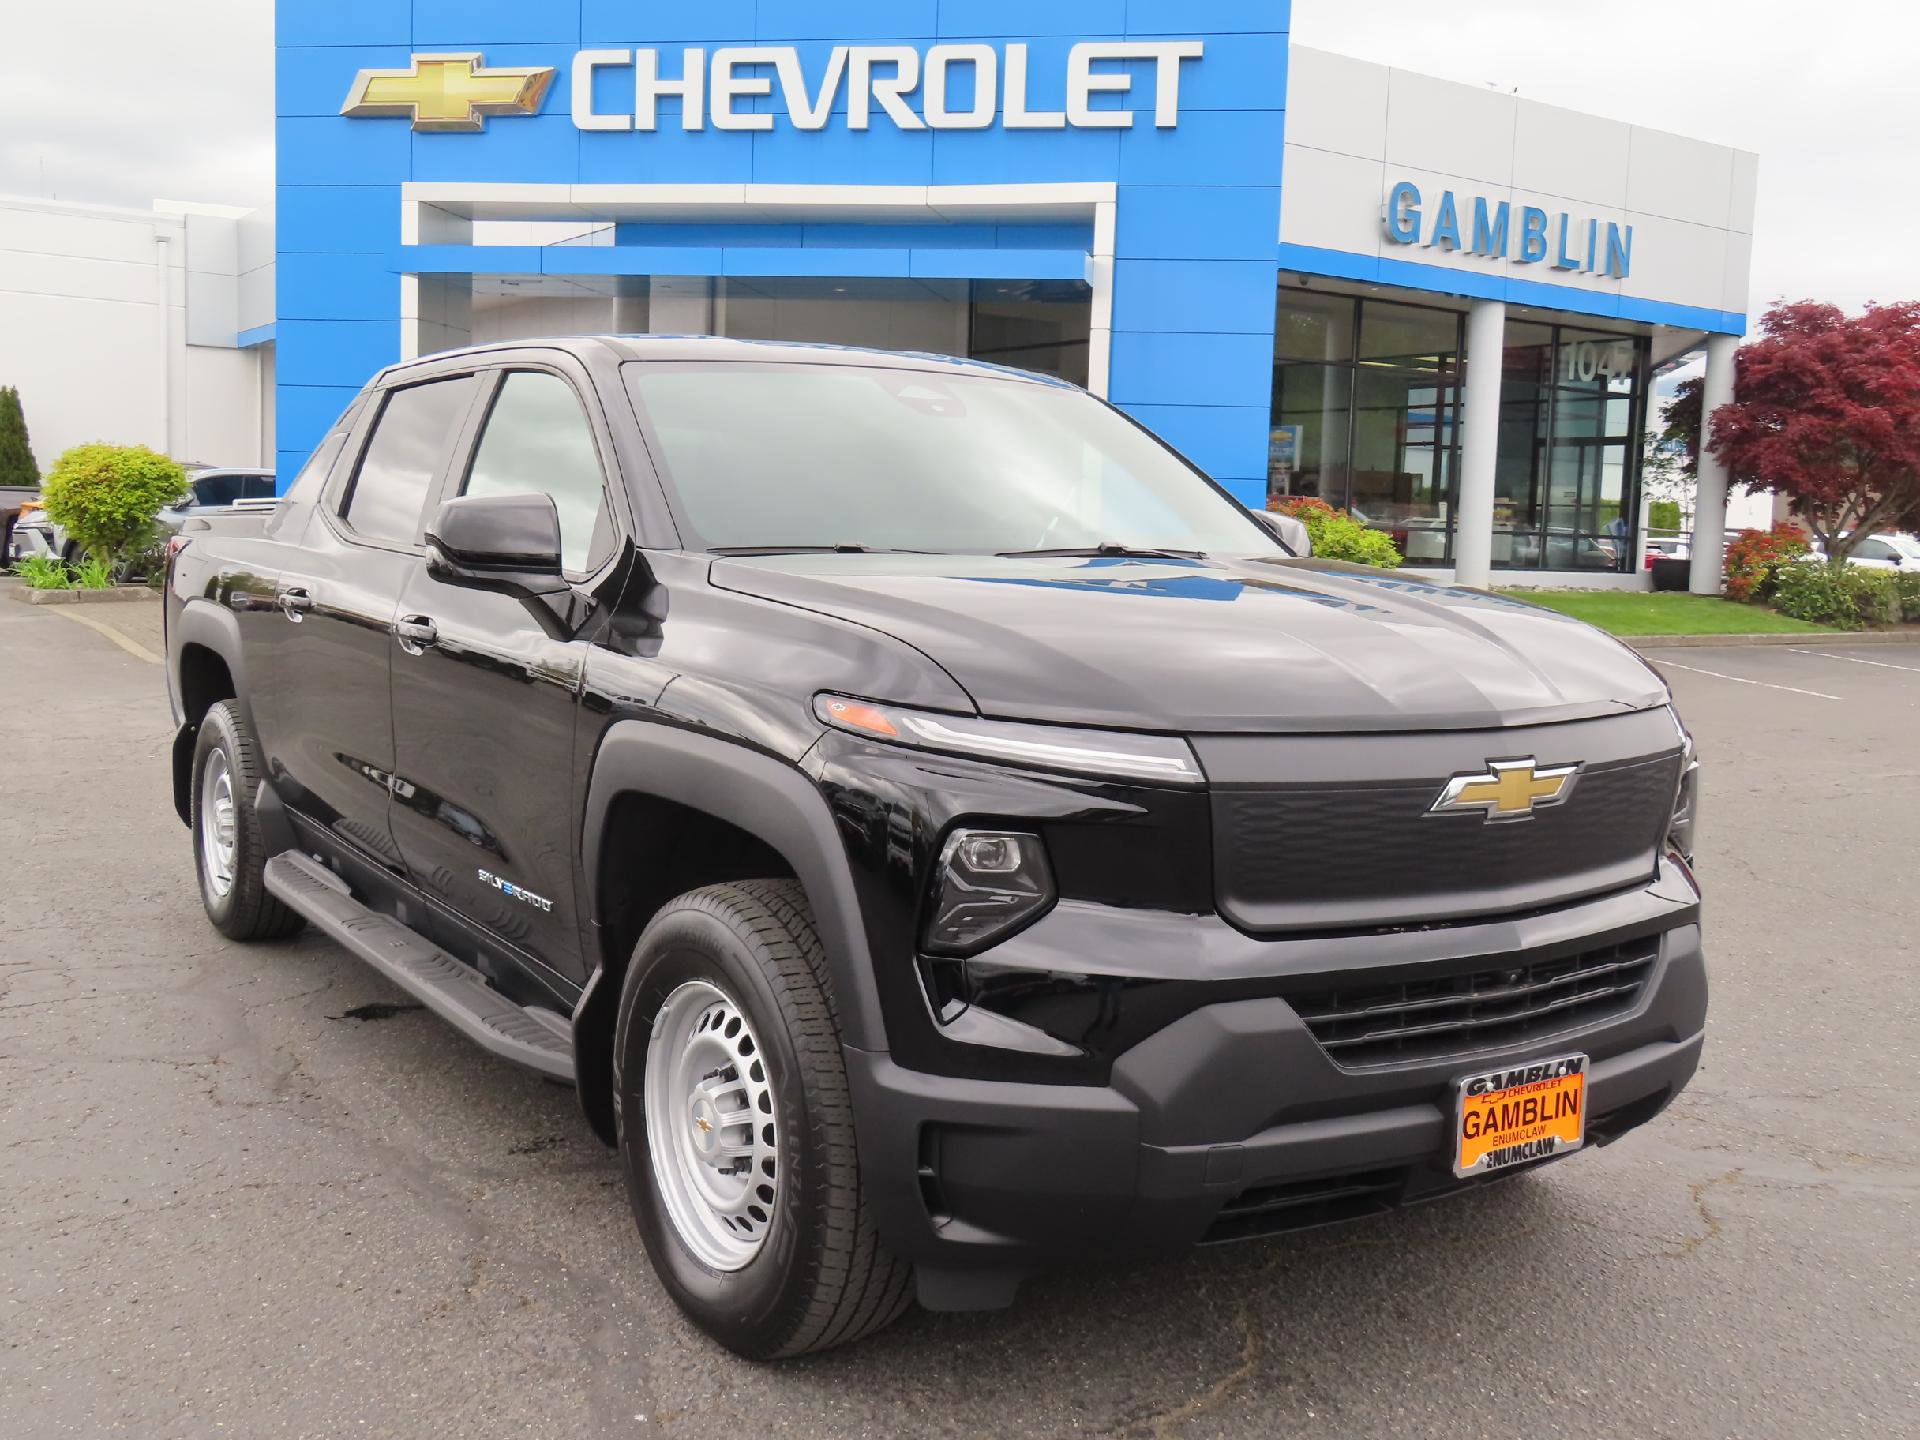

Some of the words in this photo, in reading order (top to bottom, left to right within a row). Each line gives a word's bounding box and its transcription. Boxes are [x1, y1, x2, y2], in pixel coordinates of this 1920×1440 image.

[571, 41, 1204, 131] CHEVROLET
[1387, 181, 1633, 280] GAMBLIN
[1566, 341, 1636, 386] 1047
[1466, 1057, 1584, 1097] GAMBLIN
[1508, 1079, 1563, 1098] CHEVROLET
[1463, 1088, 1578, 1140] GAMBLIN
[1486, 1135, 1556, 1169] ENUMCLAW
[1492, 1124, 1546, 1147] ENUMCLAW
